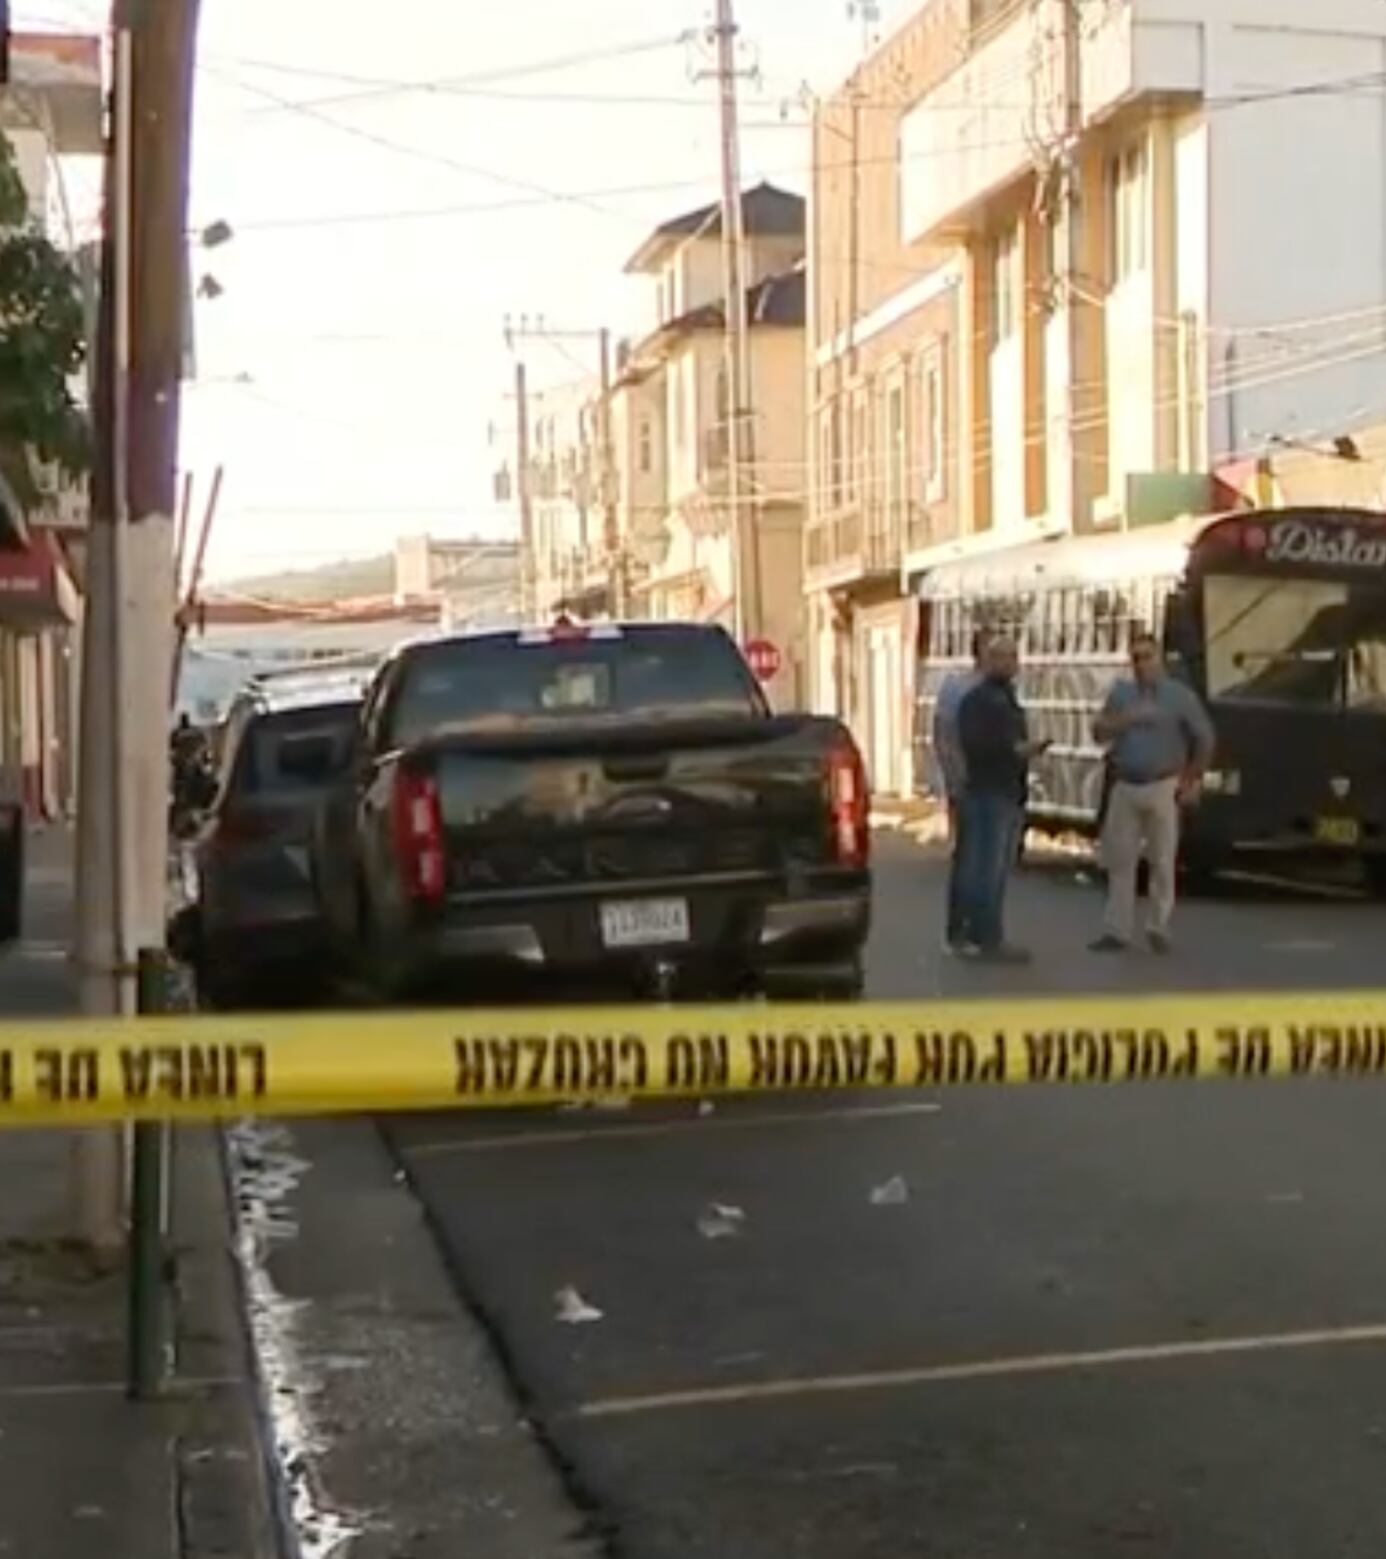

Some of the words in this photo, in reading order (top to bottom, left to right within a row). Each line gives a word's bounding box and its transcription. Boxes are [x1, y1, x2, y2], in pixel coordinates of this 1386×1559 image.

[34, 1048, 98, 1103] DE
[118, 1042, 266, 1101] LINEA
[454, 1034, 647, 1097] CRUZAR
[667, 1034, 730, 1091] NO
[748, 1032, 897, 1089] FAVOR
[915, 1030, 1006, 1085] POR
[1023, 1026, 1199, 1085] POLICIA
[1215, 1025, 1272, 1077] DE
